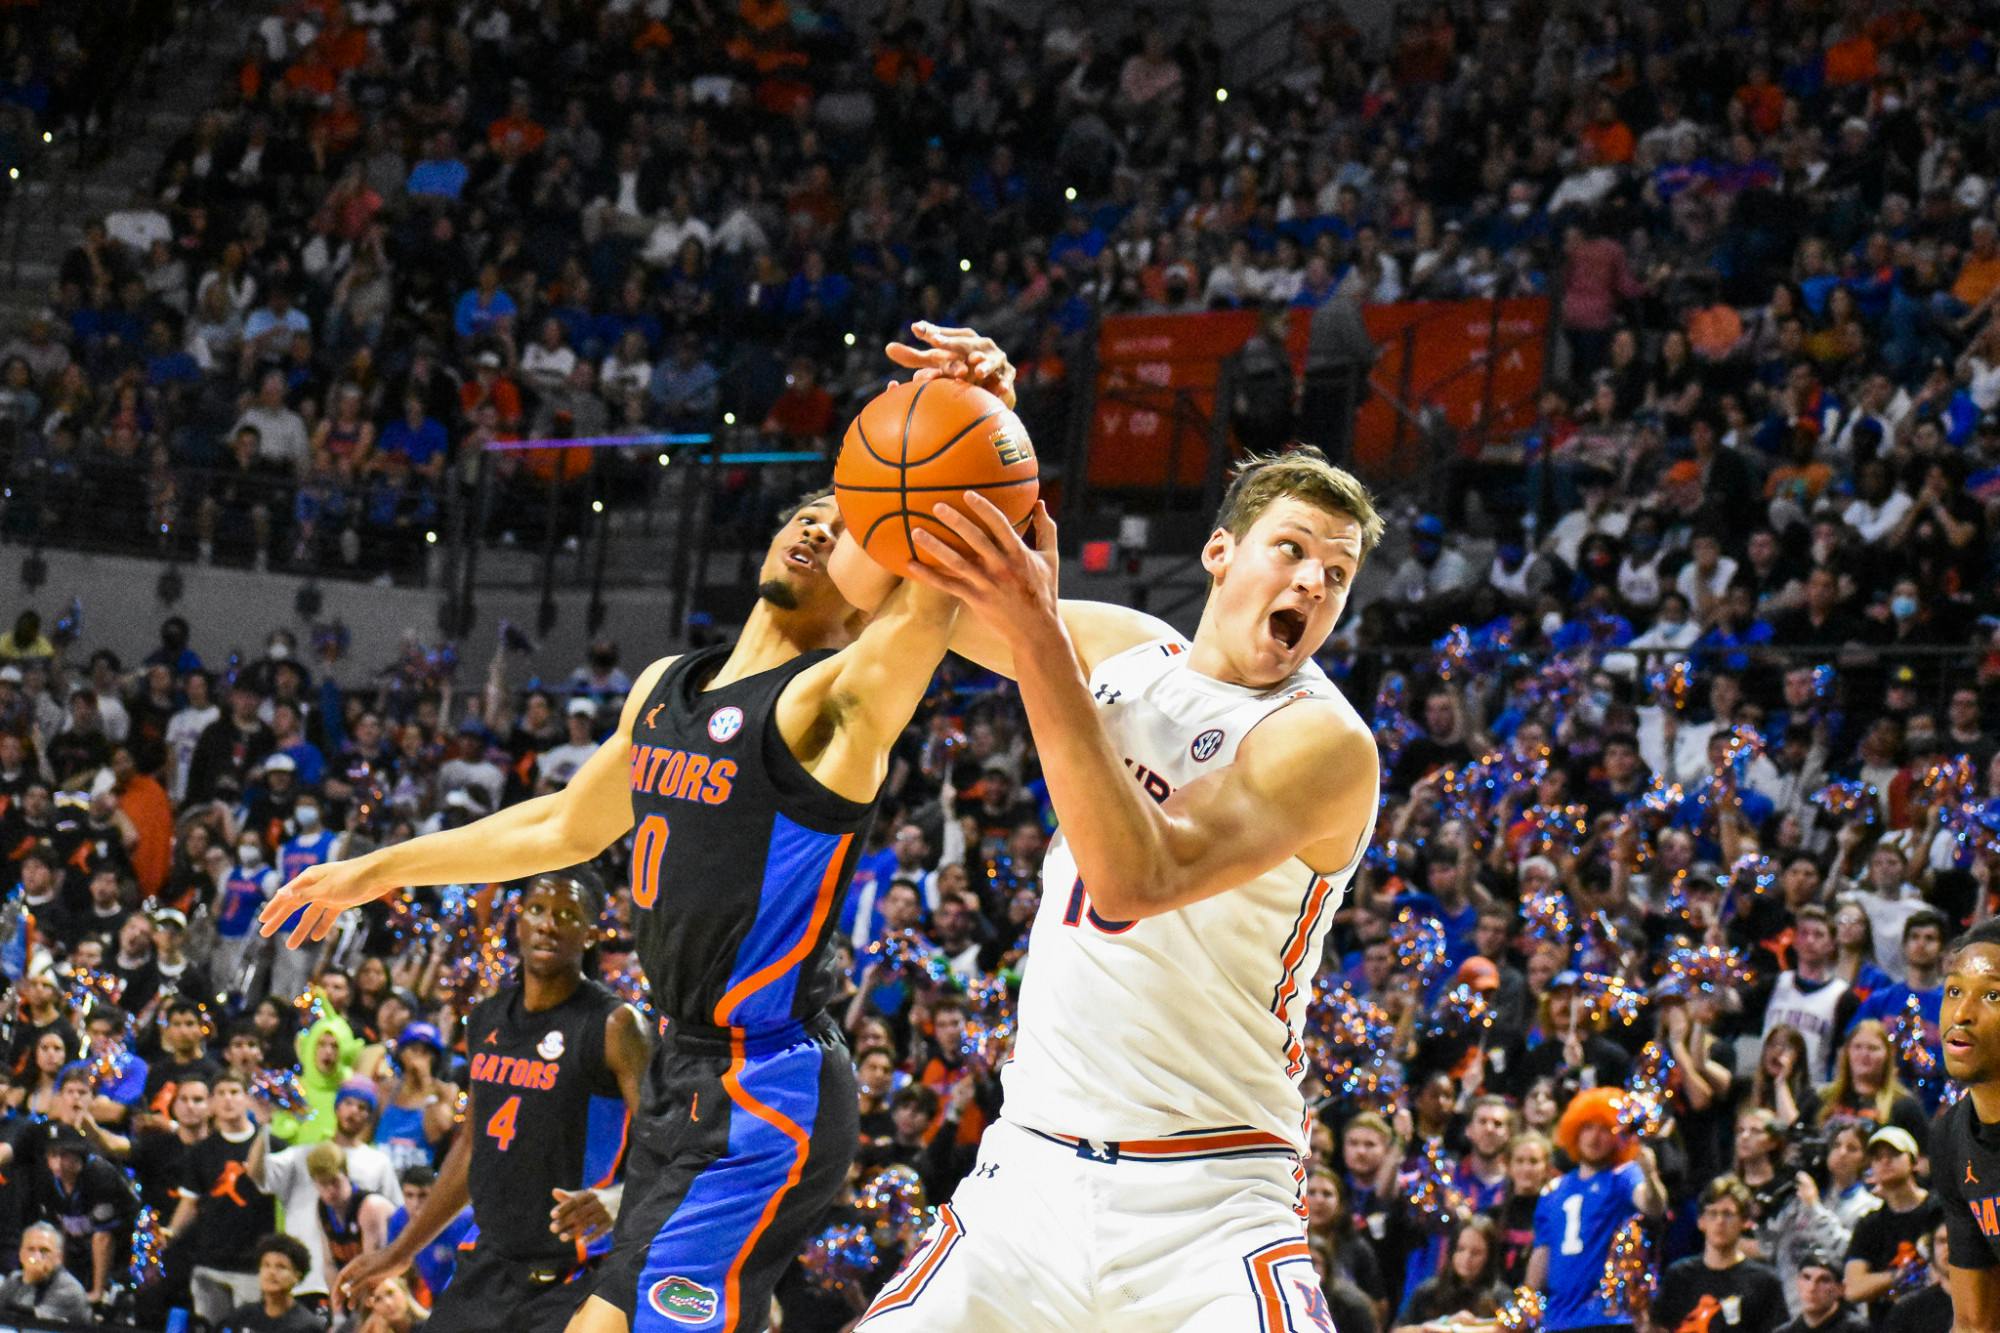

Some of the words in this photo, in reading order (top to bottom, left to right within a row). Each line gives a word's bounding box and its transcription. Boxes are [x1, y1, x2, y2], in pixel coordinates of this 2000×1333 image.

[631, 743, 739, 805] ATORS
[1191, 730, 1223, 761] SEC
[631, 812, 670, 910] 0
[470, 1052, 560, 1091] GATORS
[487, 1094, 522, 1152] 4
[1560, 1193, 1584, 1256] 1
